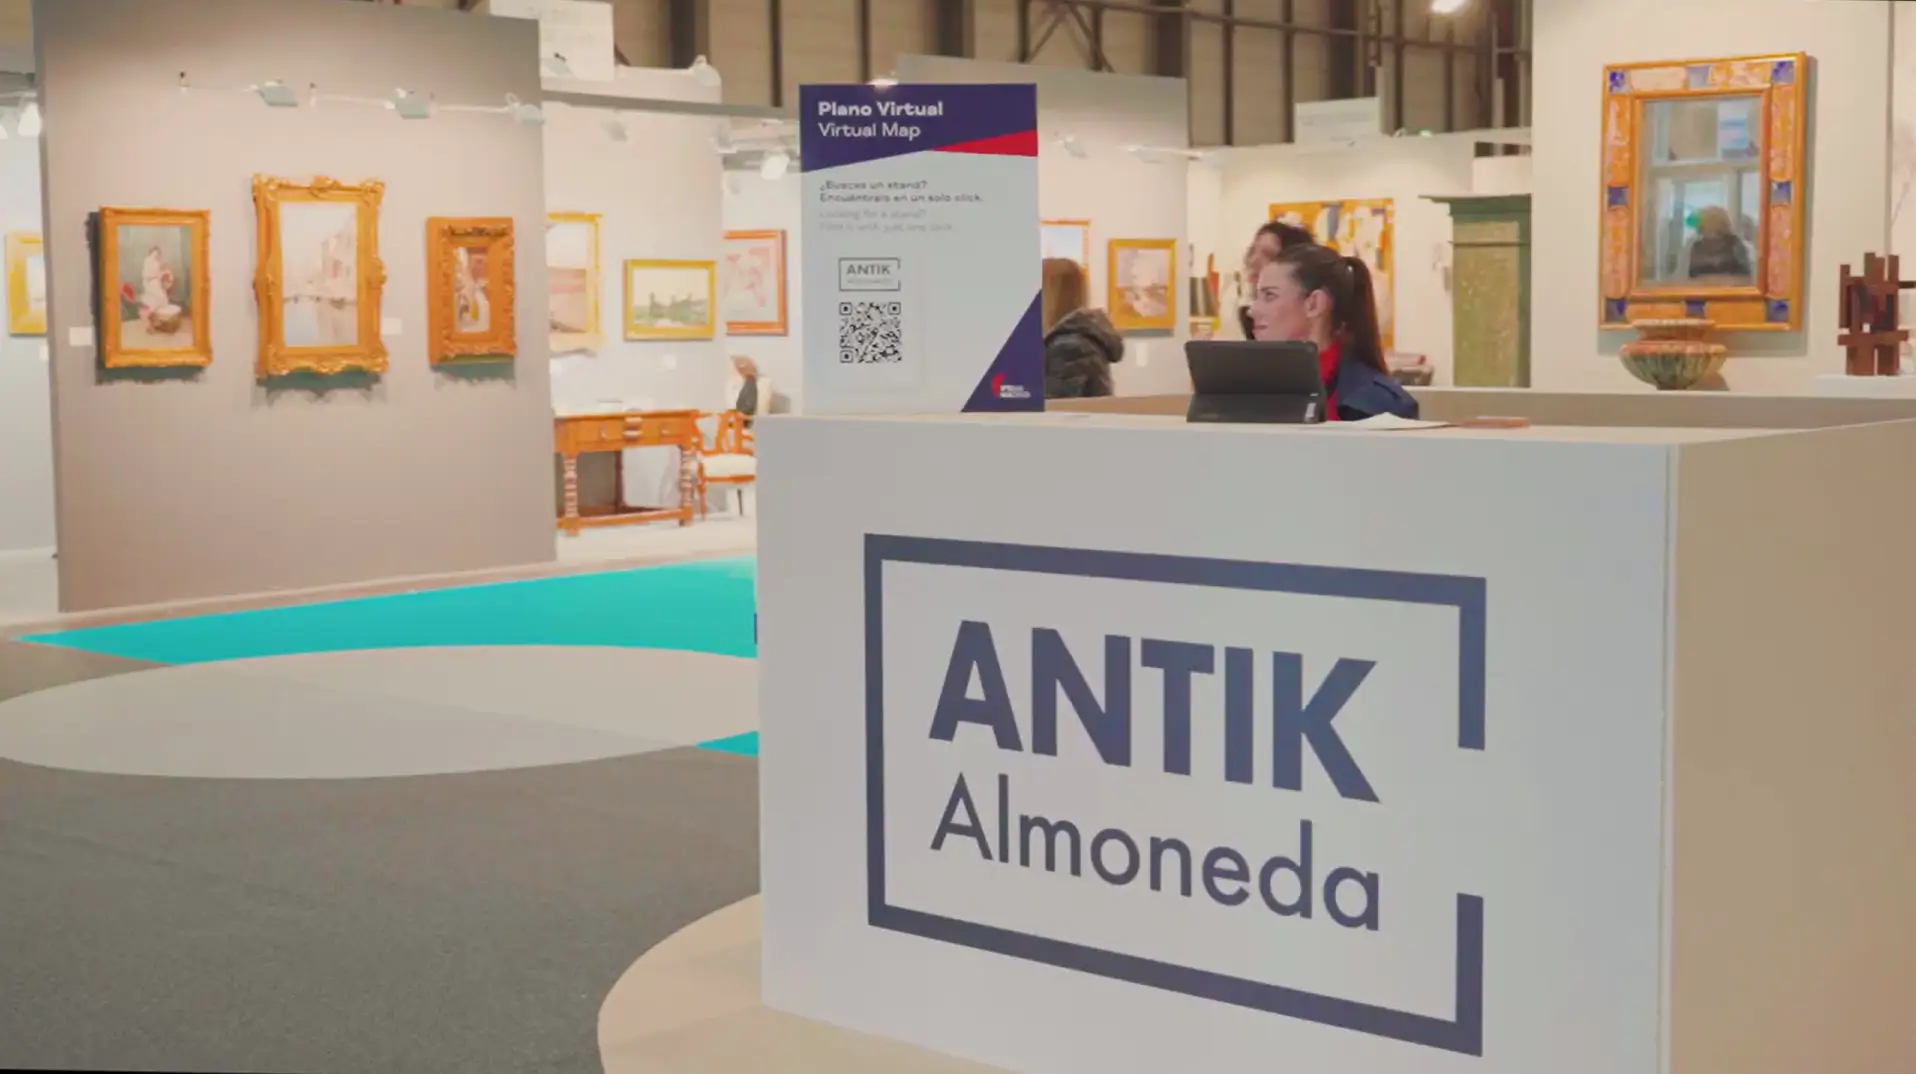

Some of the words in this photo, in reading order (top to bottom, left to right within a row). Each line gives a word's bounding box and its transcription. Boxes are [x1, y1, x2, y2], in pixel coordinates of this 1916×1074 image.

[818, 100, 872, 117] Plano
[877, 100, 943, 117] Virtual
[818, 122, 877, 138] Virtual
[882, 122, 921, 141] Map
[847, 264, 891, 275] ANTIK
[929, 619, 1381, 803] ANTIK
[930, 772, 1379, 931] Almoneda
